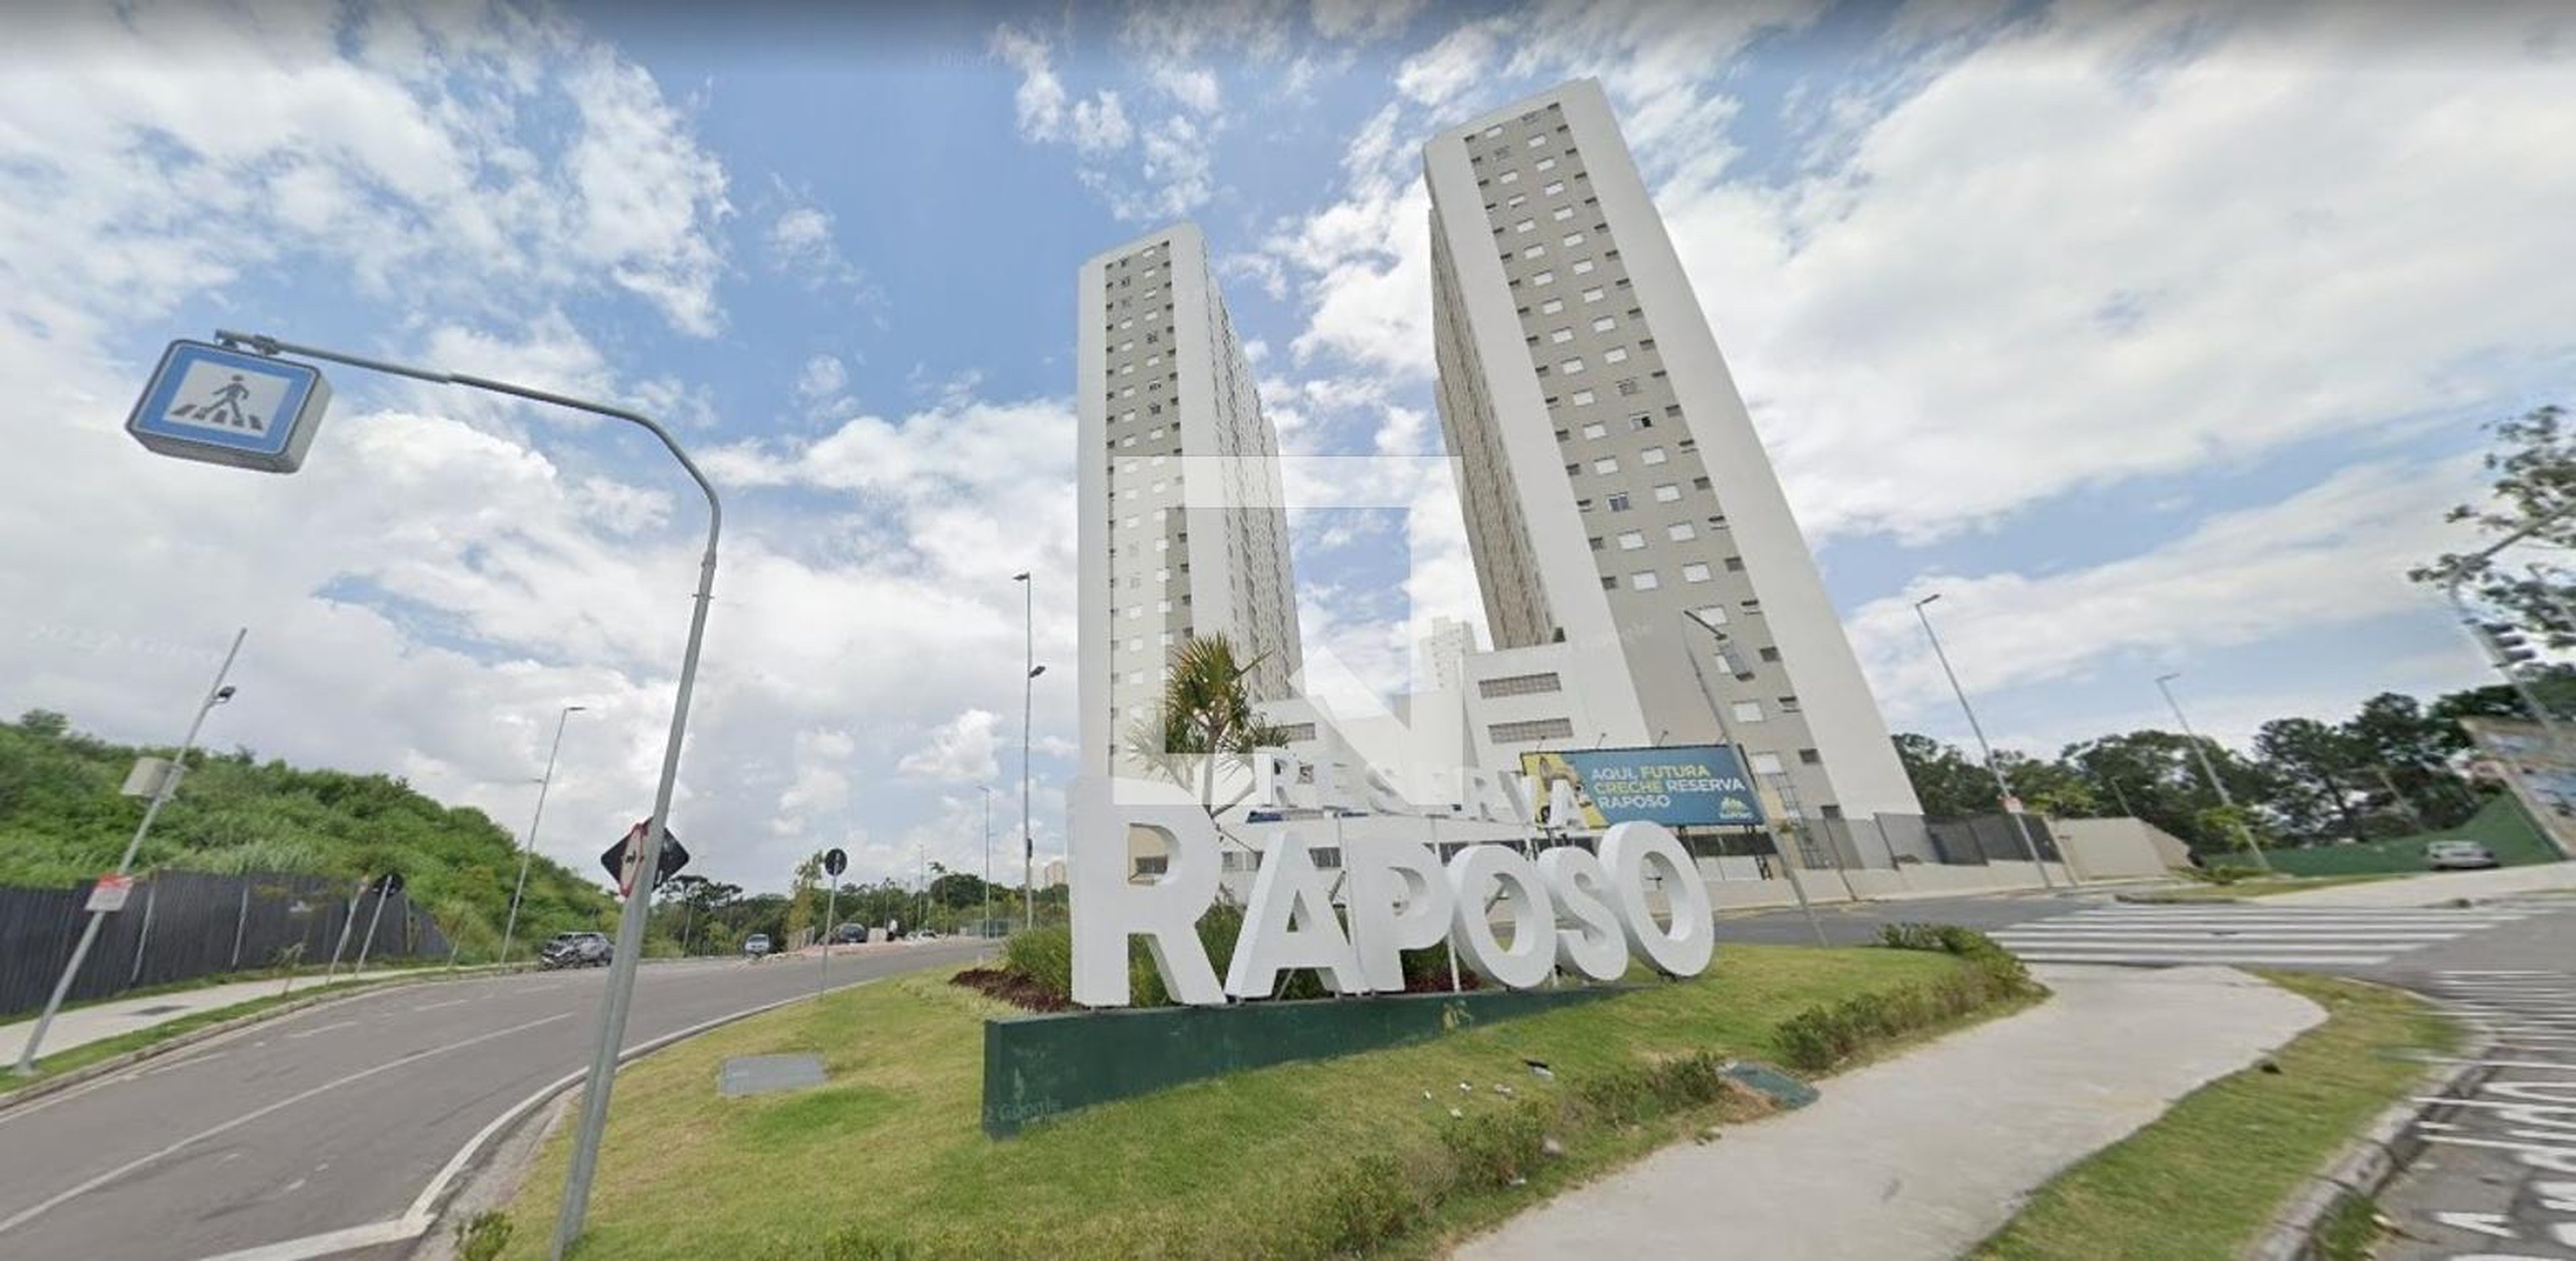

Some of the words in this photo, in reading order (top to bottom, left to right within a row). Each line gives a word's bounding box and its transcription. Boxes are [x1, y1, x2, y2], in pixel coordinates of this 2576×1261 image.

[1640, 764, 1711, 779] FUTURA
[1594, 780, 1664, 796] CRECHE
[1666, 777, 1746, 792] RESERVA
[1597, 794, 1671, 809] RAPOSO
[1067, 777, 1715, 1006] RAPOSO
